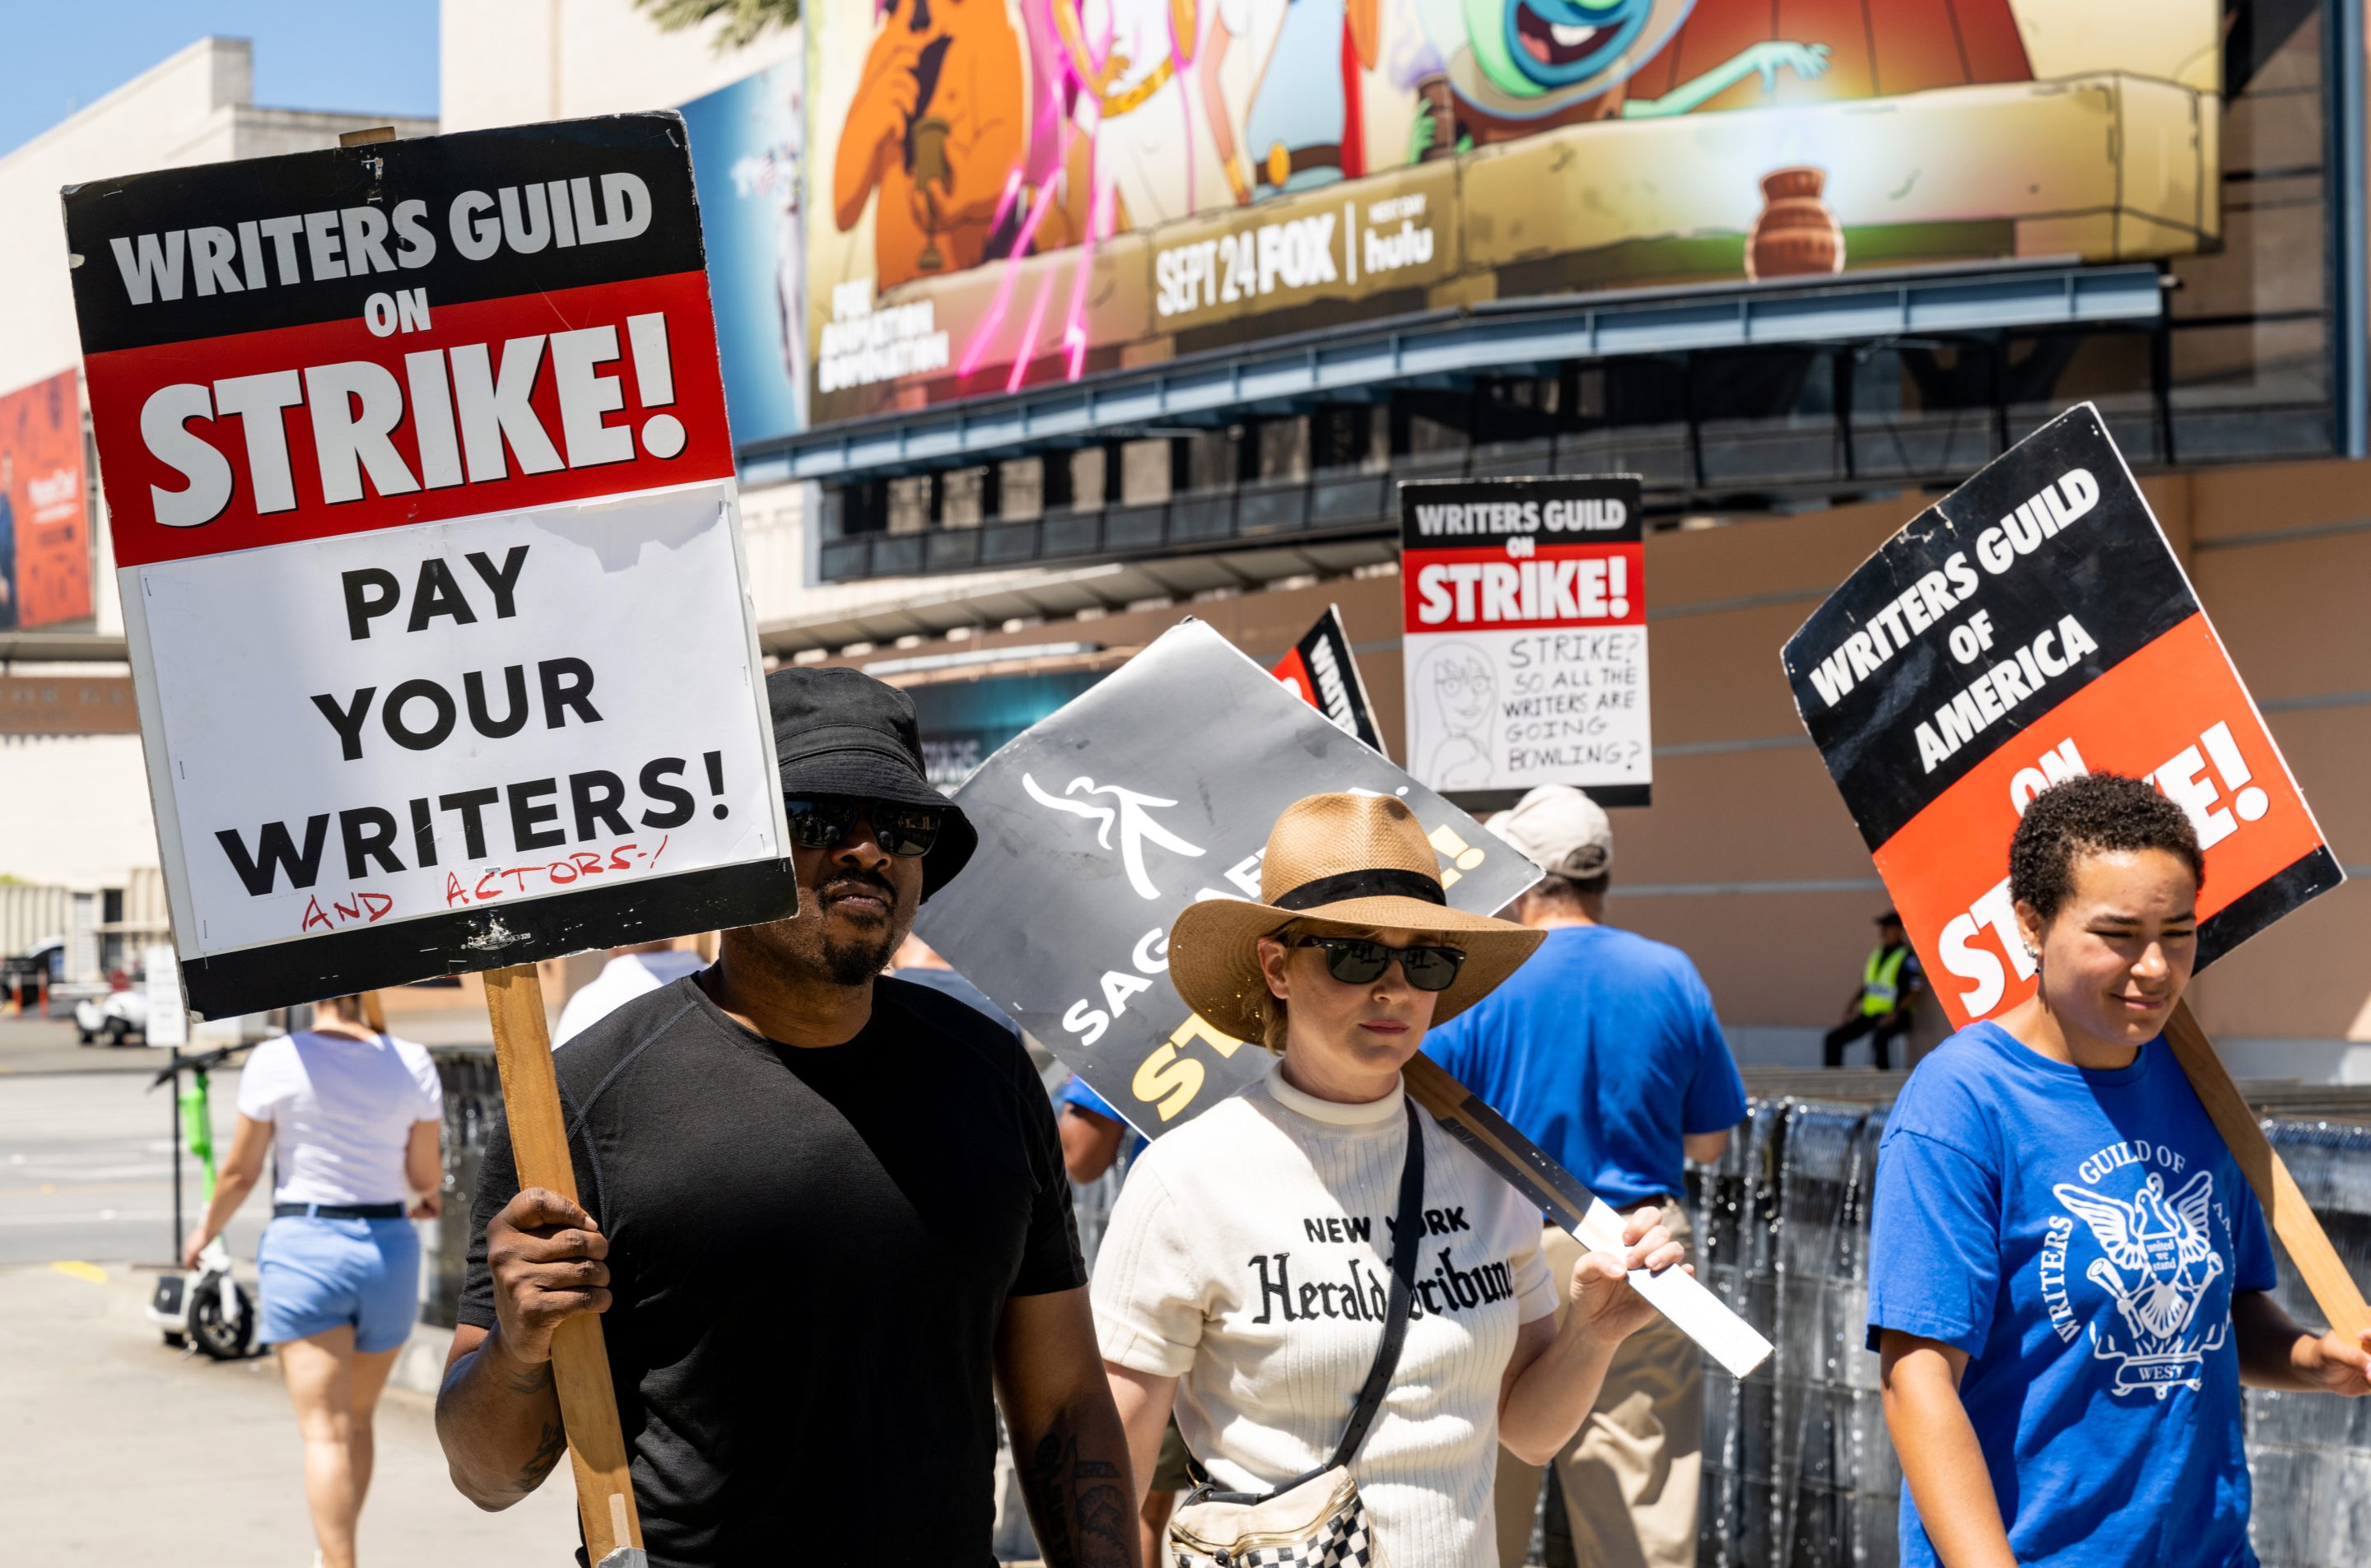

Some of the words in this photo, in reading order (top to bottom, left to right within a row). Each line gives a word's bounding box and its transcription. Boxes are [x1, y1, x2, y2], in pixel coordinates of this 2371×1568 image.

[109, 198, 436, 305] WRITERS
[449, 172, 652, 262] GUILD
[1363, 219, 1434, 273] hulu
[1156, 239, 1219, 316] SEPT
[1218, 230, 1257, 304] 24
[1256, 212, 1338, 295] FOX
[364, 287, 431, 337] ON
[140, 311, 687, 527] STRIKE!
[1415, 501, 1540, 535] WRITERS
[1543, 499, 1627, 533] GUILD
[1506, 537, 1535, 558] ON
[341, 546, 530, 641] PAY
[1418, 556, 1629, 624] STRIKE!
[1809, 551, 1978, 708] WRITERS
[1976, 468, 2099, 575] GUILD
[1508, 633, 1640, 668] STRIKE?
[1949, 608, 1994, 664] OF
[1502, 692, 1588, 718] WRITERS
[1596, 690, 1636, 710] ARE
[1512, 672, 1544, 696] SO
[1552, 670, 1592, 690] ALL
[1601, 666, 1637, 685] THE
[1914, 614, 2098, 775] AMERICA
[310, 657, 603, 761] YOUR
[1504, 715, 1607, 742] GOING
[1508, 741, 1642, 772] BOWLING?
[214, 751, 729, 896] WRITERS!
[302, 892, 393, 932] AND
[1304, 1216, 1371, 1243] NEW
[2040, 1216, 2081, 1343] WRITERS
[2078, 1140, 2152, 1184] GUILD
[2156, 1145, 2187, 1175] OF
[2146, 1238, 2175, 1253] united
[2153, 1257, 2177, 1272] stand
[2155, 1252, 2169, 1260] we
[1248, 1252, 1386, 1324] Herald
[2139, 1365, 2185, 1382] WEST
